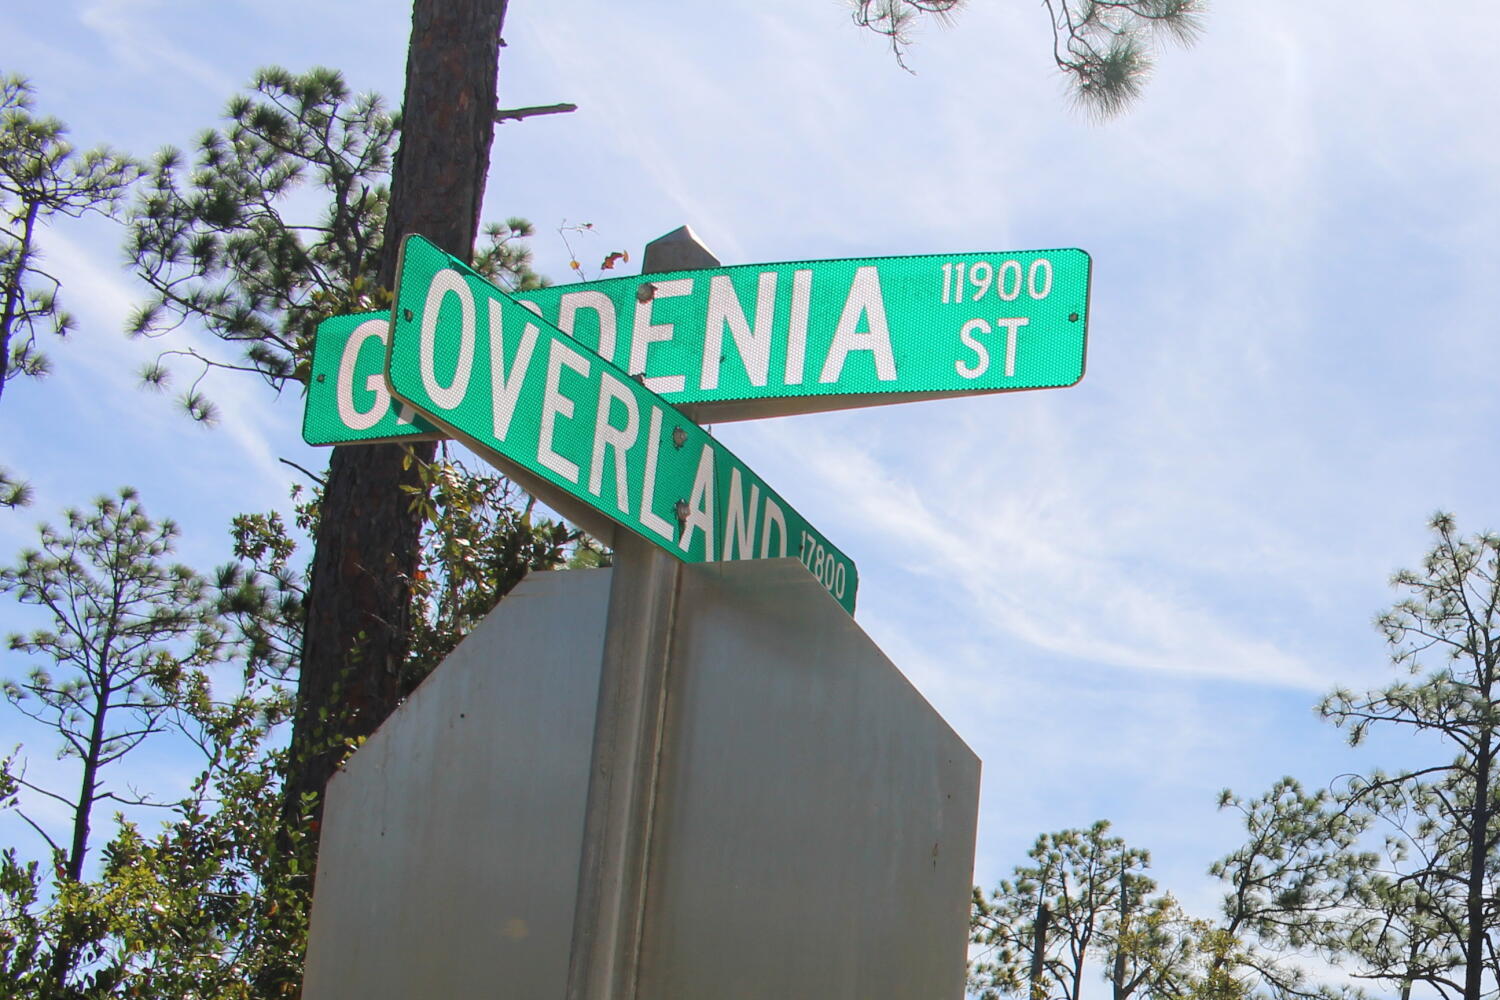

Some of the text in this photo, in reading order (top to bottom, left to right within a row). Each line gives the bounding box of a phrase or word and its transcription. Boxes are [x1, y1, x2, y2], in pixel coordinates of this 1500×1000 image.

[941, 257, 1054, 305] 11900
[336, 264, 899, 430] GDENIA
[953, 316, 1030, 380] ST
[419, 267, 788, 563] OVERLAND
[800, 530, 846, 600] 17800
